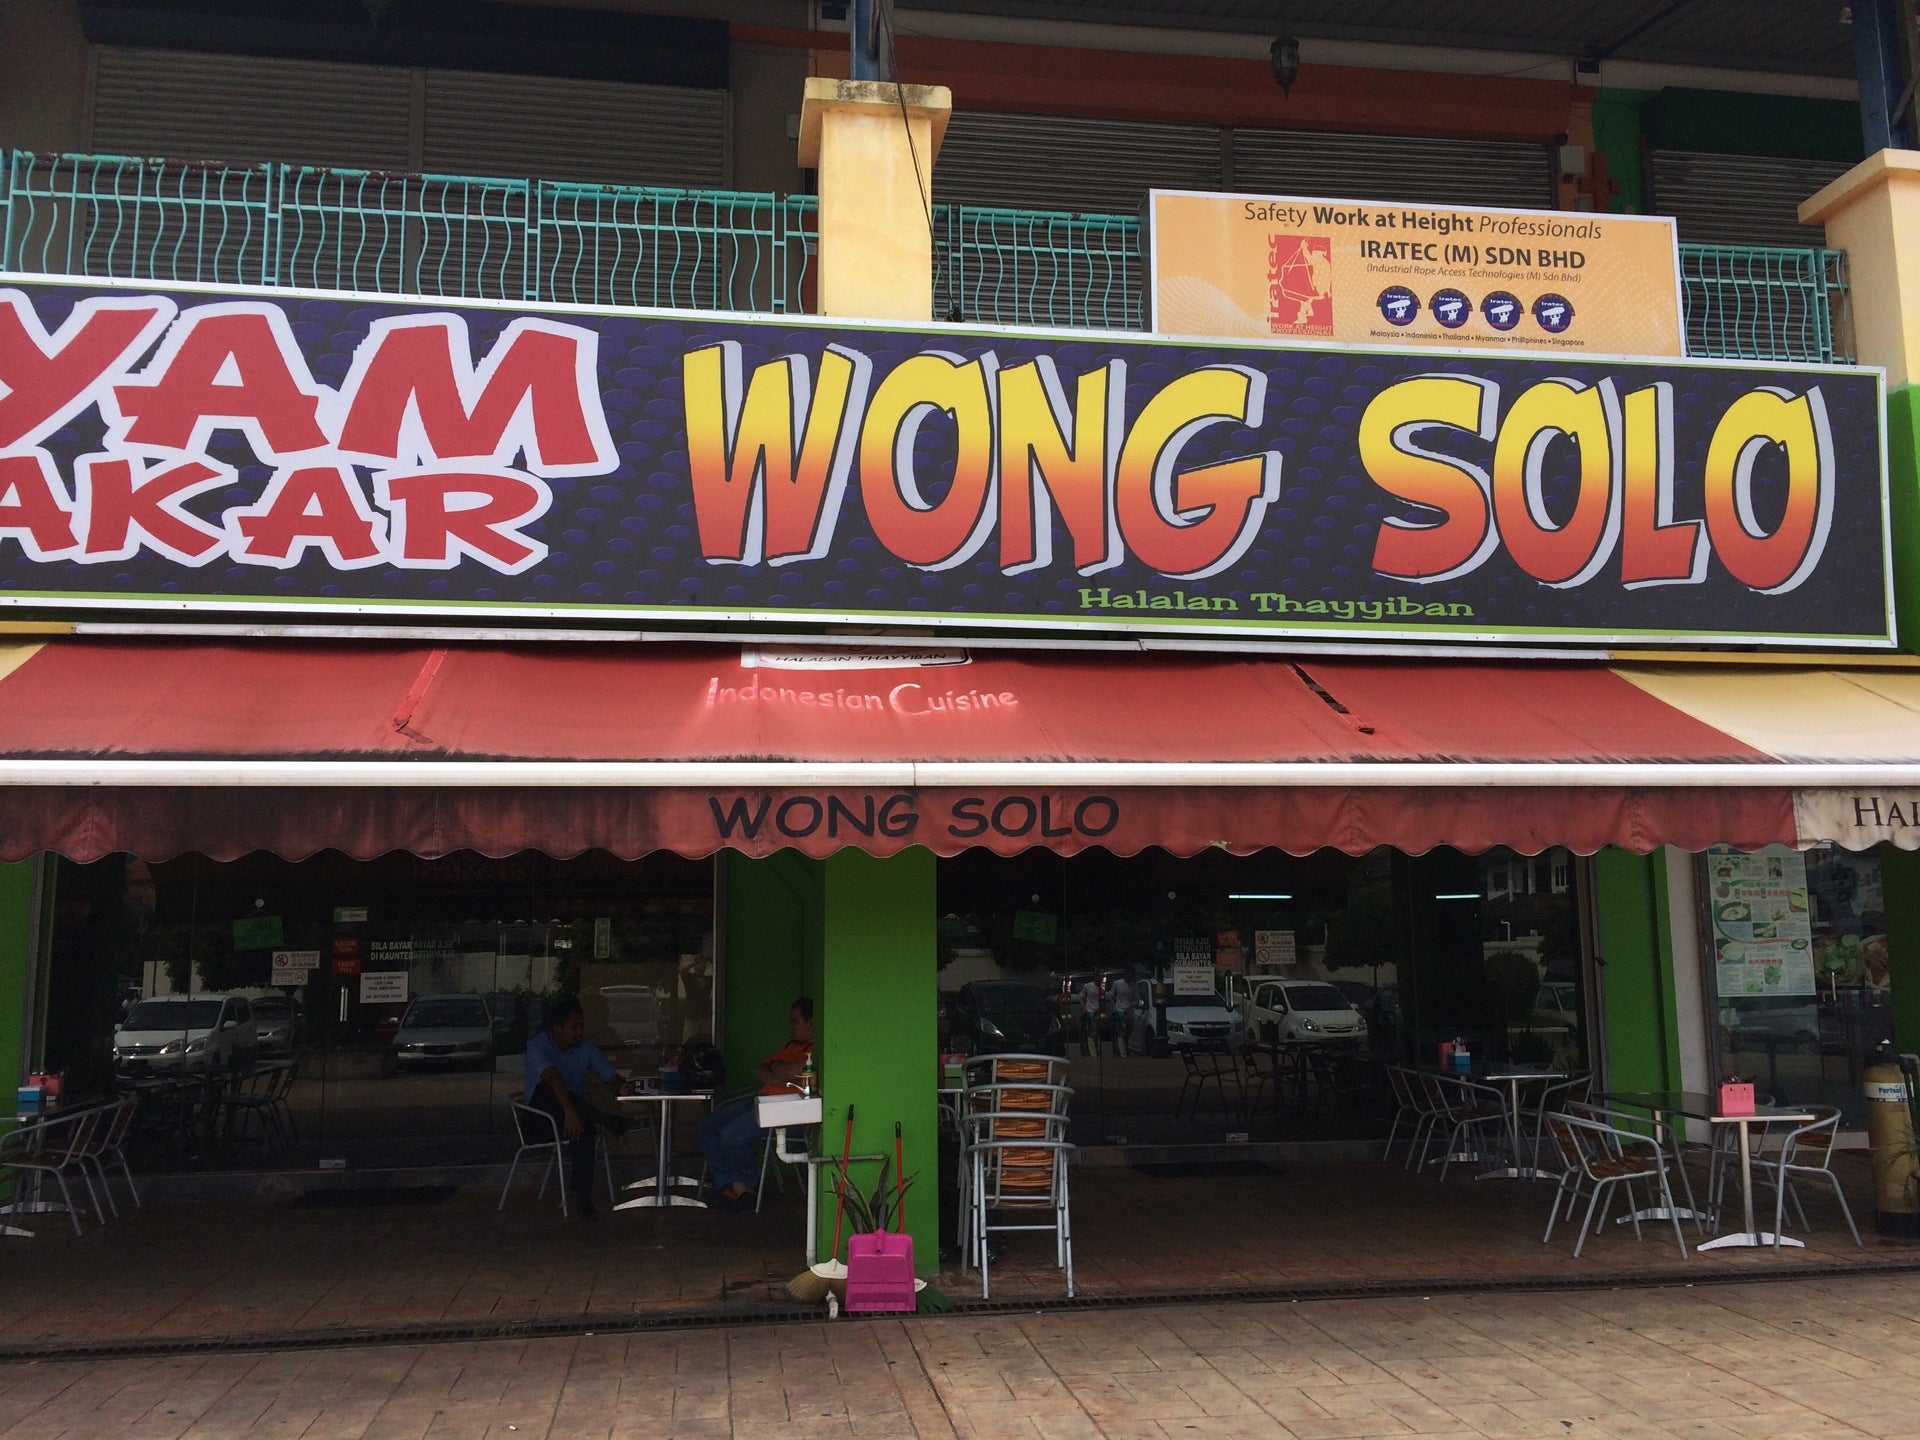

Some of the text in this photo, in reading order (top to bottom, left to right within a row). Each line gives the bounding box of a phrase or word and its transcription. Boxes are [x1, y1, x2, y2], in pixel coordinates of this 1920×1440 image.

[1244, 202, 1602, 239] Safety Work at Height Professionals
[1360, 239, 1585, 269] IRATEC (M) SDN BHD
[1366, 264, 1581, 283] (Industrial Rope Access Technologies (M) Sdn Bhd)
[1370, 330, 1400, 339] Malaysia
[1404, 332, 1437, 341] Indonesia
[1442, 333, 1470, 341] Thailand
[1474, 335, 1506, 344] Myanmar
[1551, 338, 1584, 347] Singapore
[683, 340, 1835, 595] WONG SOLO
[1078, 588, 1475, 619] Halalan Thayyiban
[857, 652, 948, 661] THAYYIBAN
[705, 673, 1019, 716] Indonesian Cuisine
[708, 795, 1120, 838] WONG SOLO
[370, 952, 379, 961] DI
[380, 951, 414, 960] KAUNTER
[371, 941, 388, 951] SILA
[389, 941, 413, 950] BAYAR
